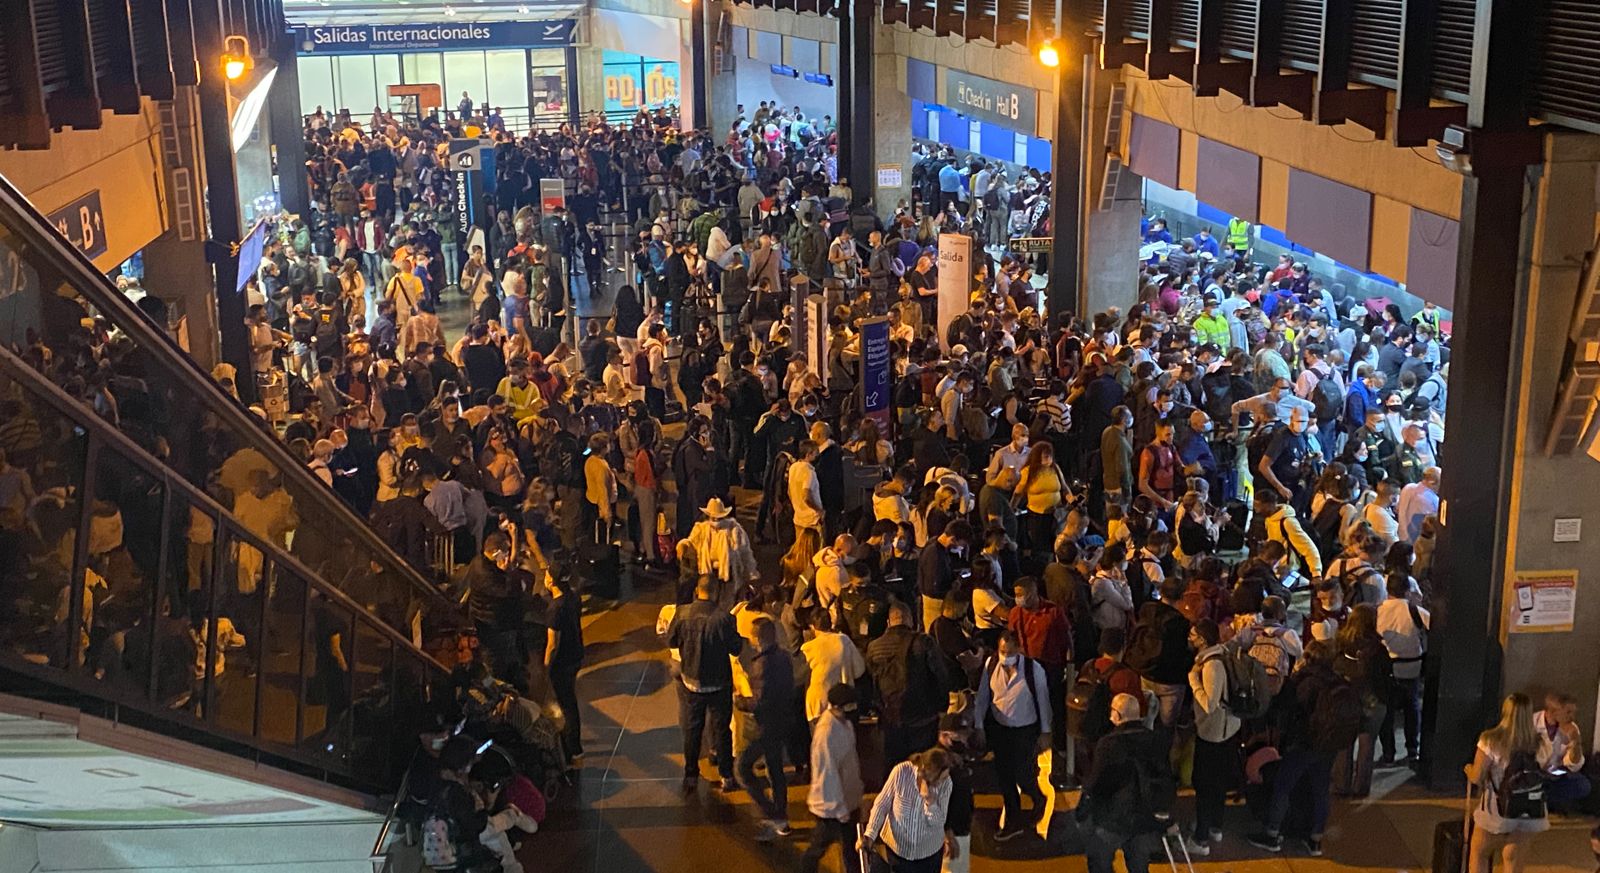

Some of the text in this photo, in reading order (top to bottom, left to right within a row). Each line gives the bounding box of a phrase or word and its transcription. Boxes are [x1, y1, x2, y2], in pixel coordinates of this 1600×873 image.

[314, 23, 491, 44] Salidas Internacionales
[965, 87, 1019, 120] Check in Hall B
[79, 206, 94, 250] B
[460, 212, 468, 234] Auto
[940, 250, 963, 262] Salida
